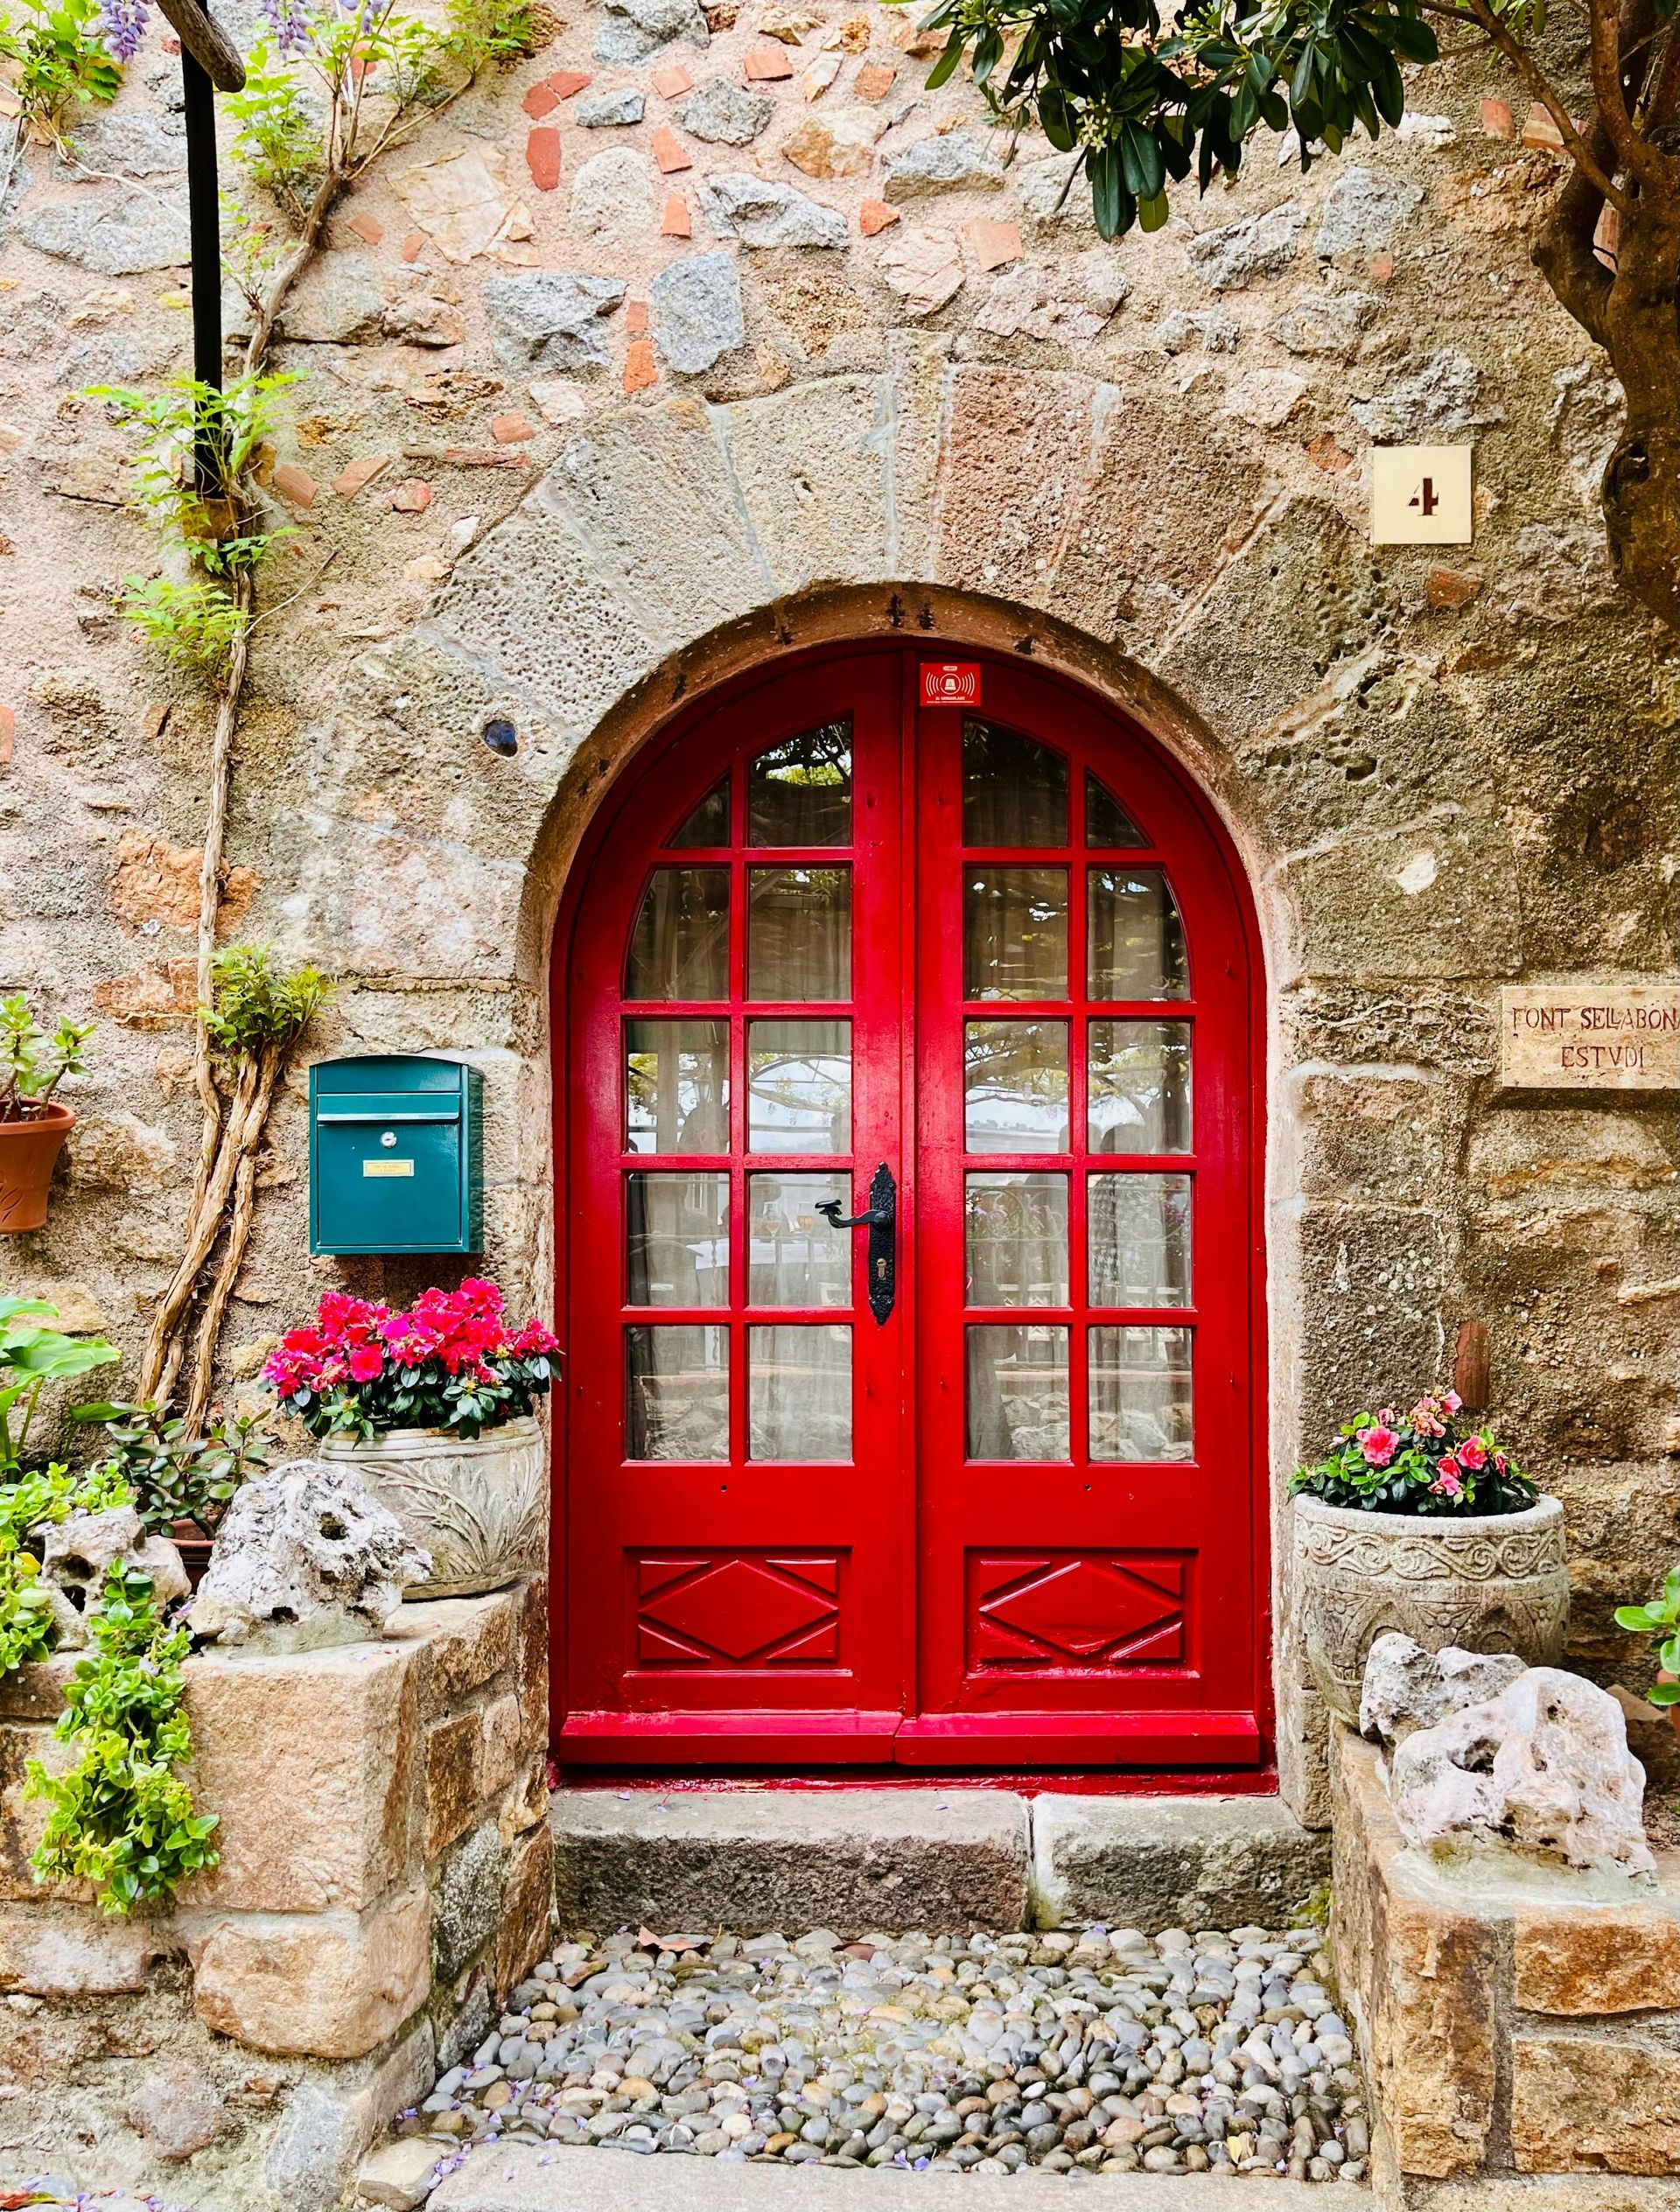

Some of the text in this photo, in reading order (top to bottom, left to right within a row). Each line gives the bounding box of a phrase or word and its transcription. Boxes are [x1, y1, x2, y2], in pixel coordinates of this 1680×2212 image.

[1407, 477, 1439, 516] 4
[1512, 1006, 1680, 1032] FONT SELLABON
[1561, 1046, 1645, 1068] ESTVDI
